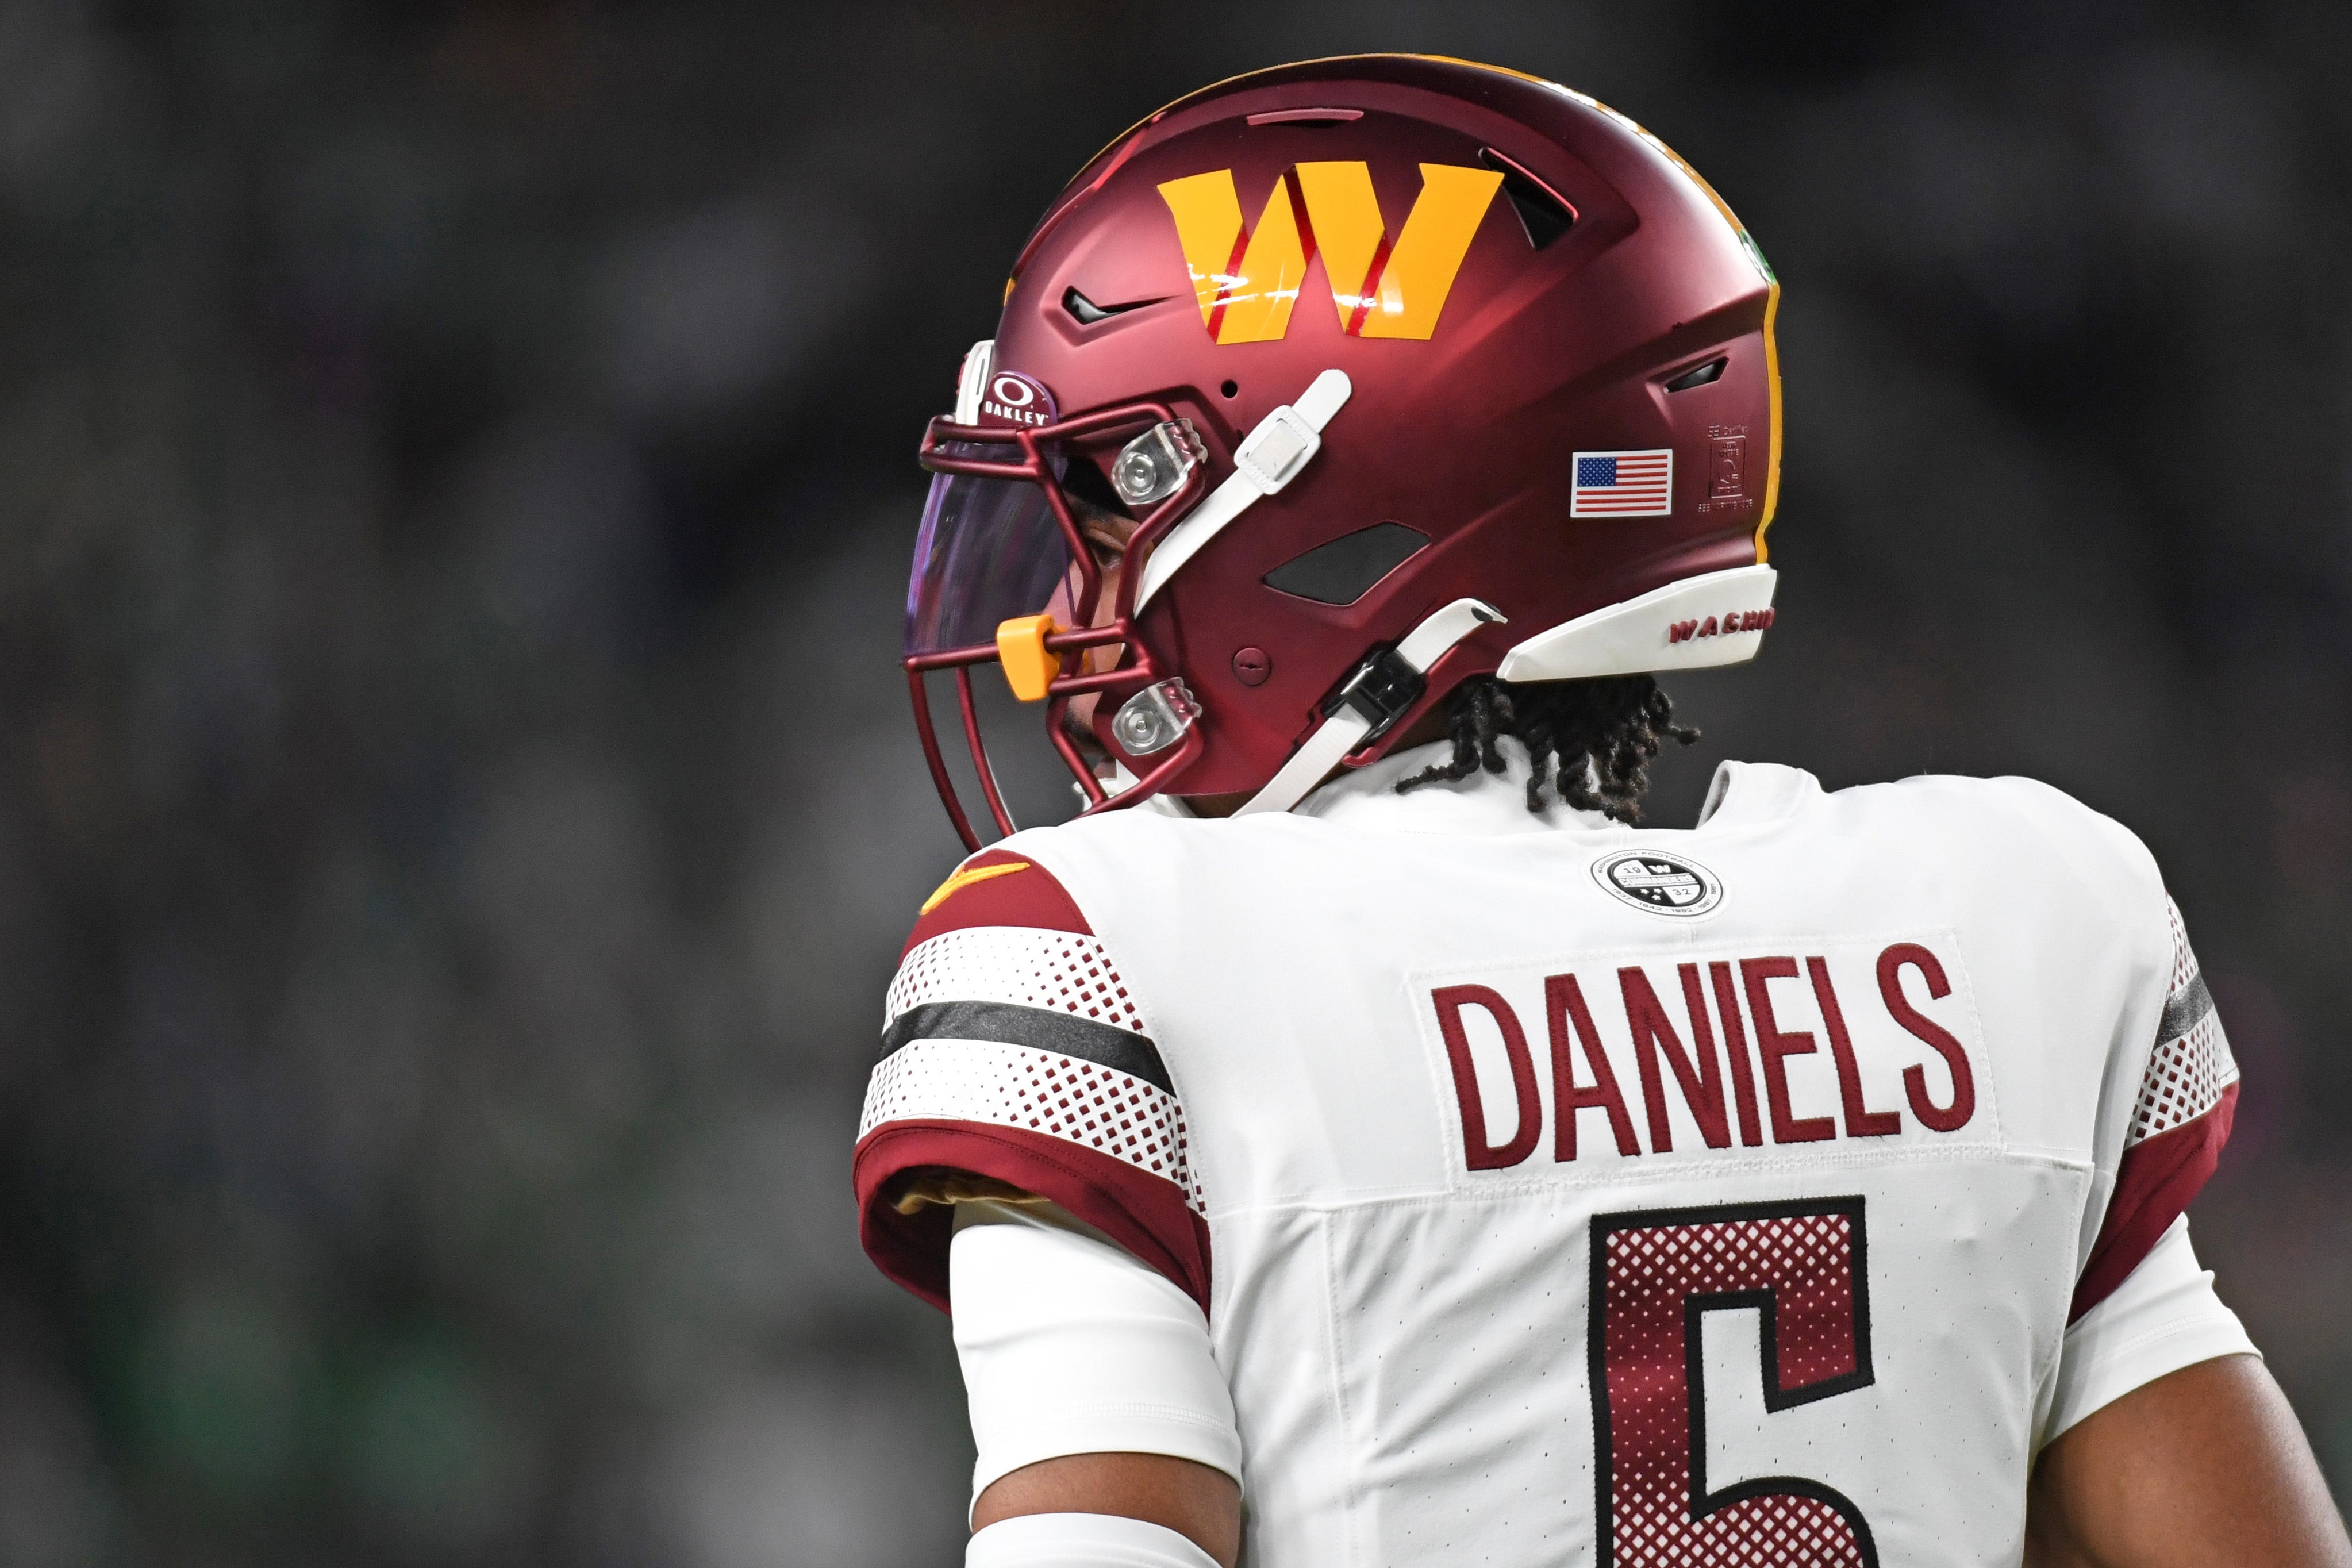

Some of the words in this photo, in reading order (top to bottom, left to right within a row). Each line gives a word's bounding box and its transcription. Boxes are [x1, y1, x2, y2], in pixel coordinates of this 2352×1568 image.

[1157, 160, 1505, 345] W
[985, 401, 1047, 425] OAKLEY
[1641, 851, 1694, 868] FOOTBALL
[1617, 874, 1697, 886] COMMANDERS
[1431, 942, 1976, 1171] DANIELS
